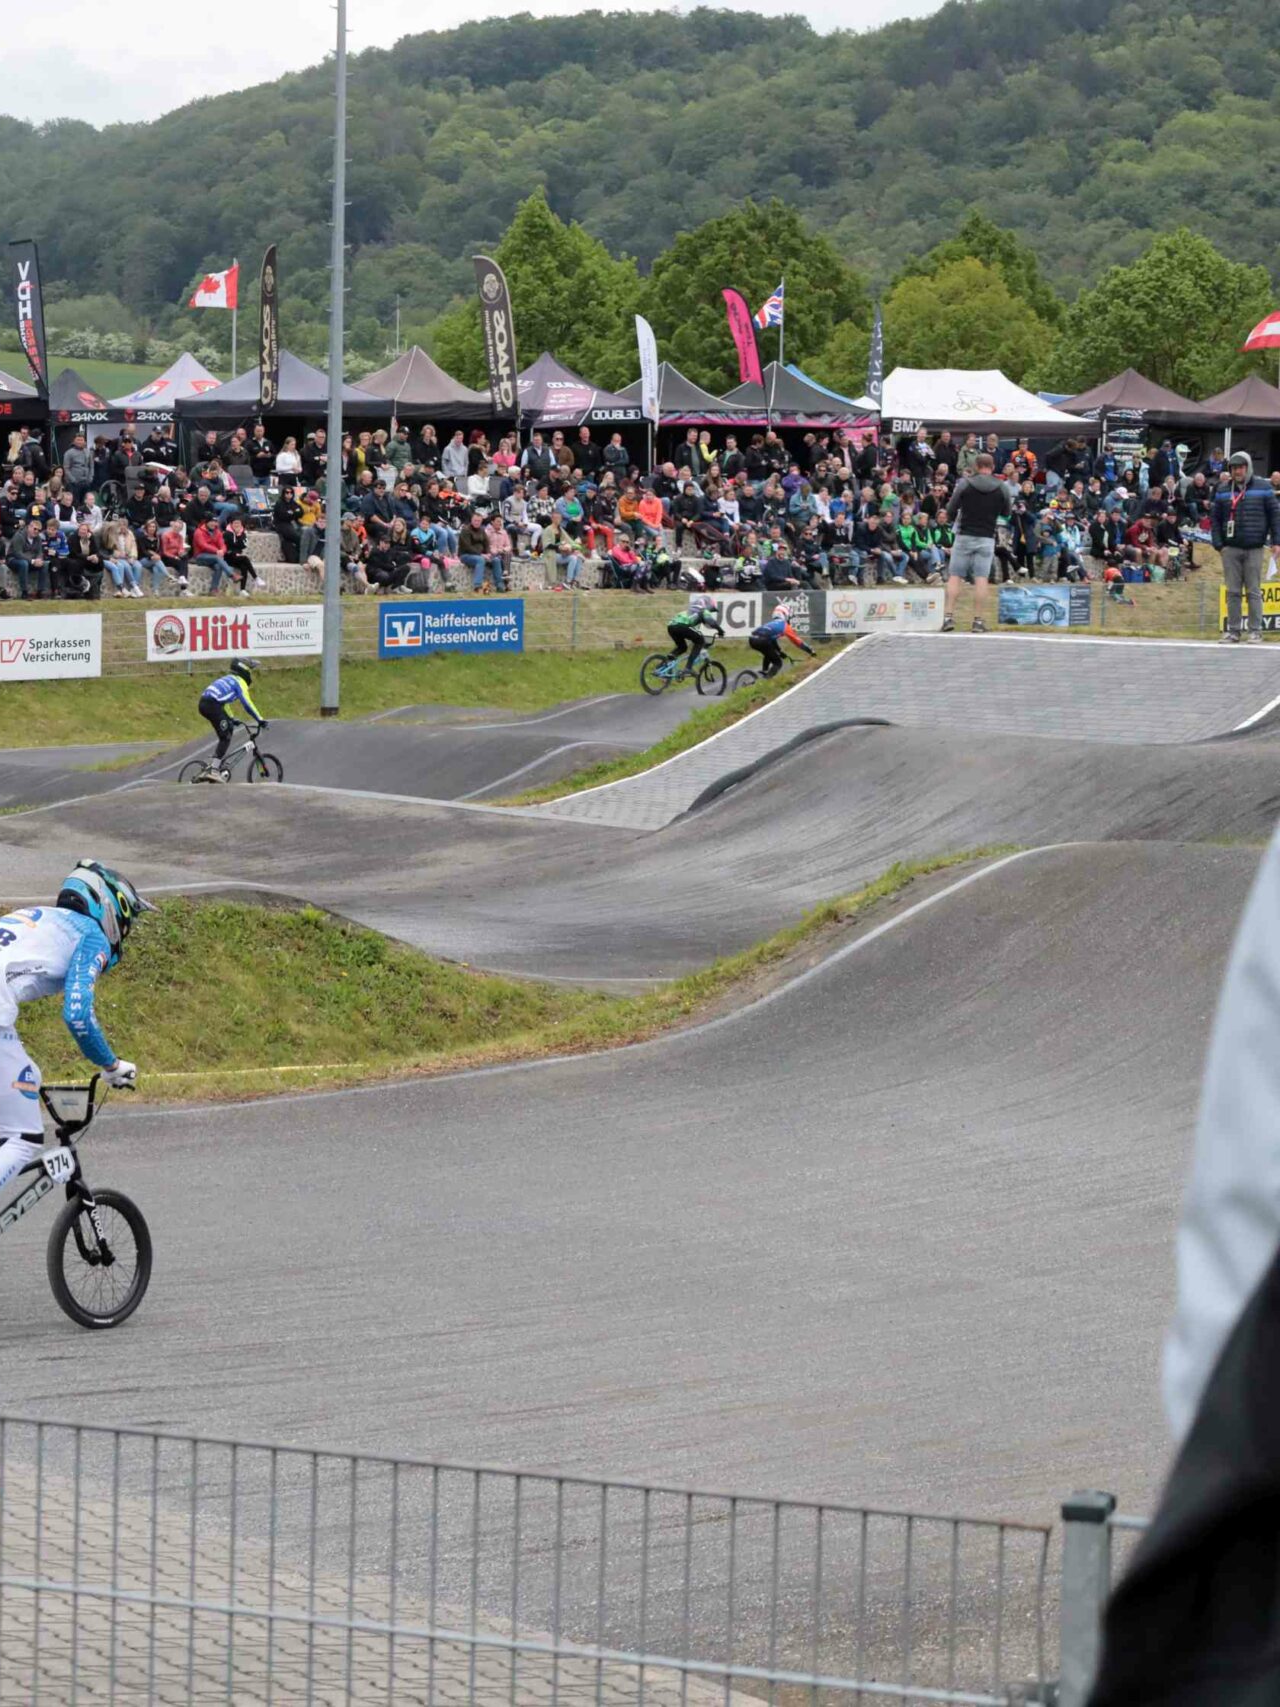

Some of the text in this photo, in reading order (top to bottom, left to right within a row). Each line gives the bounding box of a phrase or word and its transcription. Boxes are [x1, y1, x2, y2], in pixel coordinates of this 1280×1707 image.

[71, 412, 109, 422] 24MX
[137, 411, 174, 421] 24MX
[892, 420, 923, 432] BMX
[257, 618, 293, 629] Gebraut
[424, 612, 517, 628] Raiffeisenbank
[189, 614, 251, 652] Hütt
[256, 631, 313, 642] Nordhessen.
[424, 628, 519, 644] HessenNord eG
[28, 638, 91, 652] Sparkassen
[22, 650, 91, 664] Versicherung
[47, 1153, 70, 1176] 374
